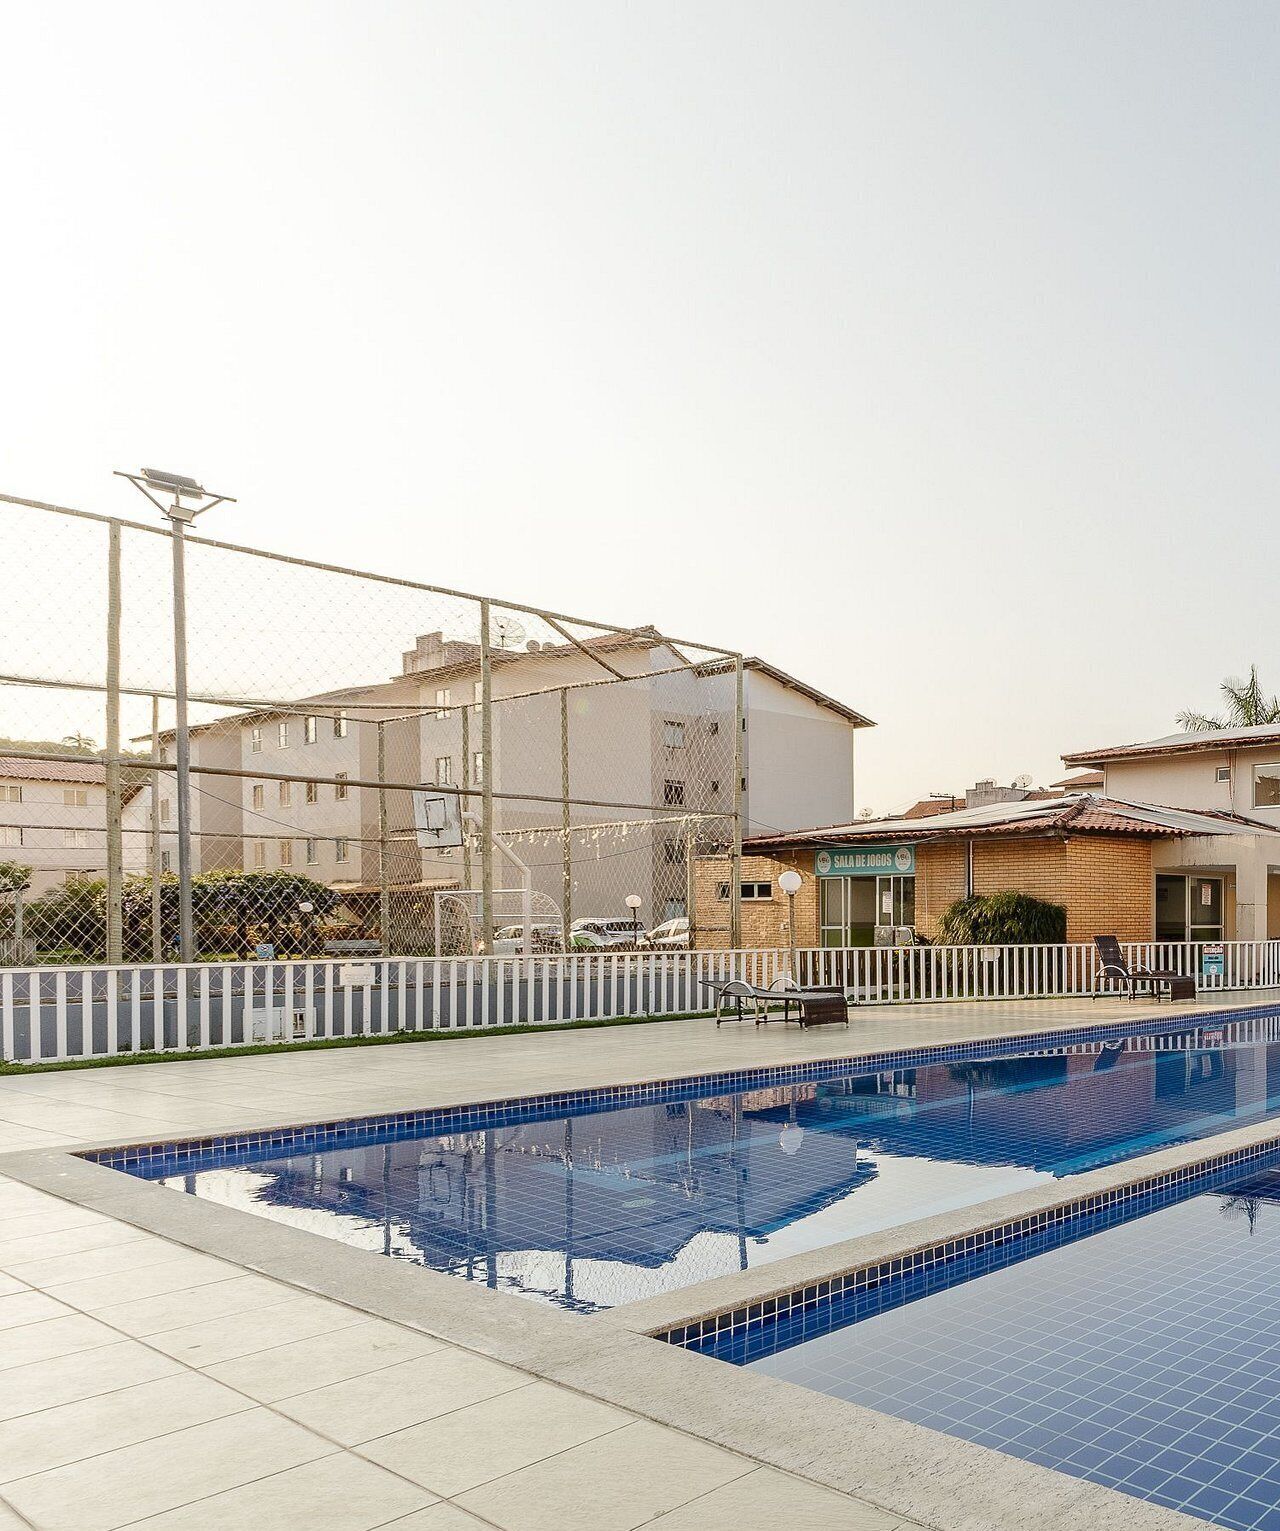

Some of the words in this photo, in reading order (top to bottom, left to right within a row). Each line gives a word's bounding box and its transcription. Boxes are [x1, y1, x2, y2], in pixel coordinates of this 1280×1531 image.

[834, 855, 854, 868] SALA
[856, 854, 866, 867] DE
[867, 853, 892, 867] JOGOS
